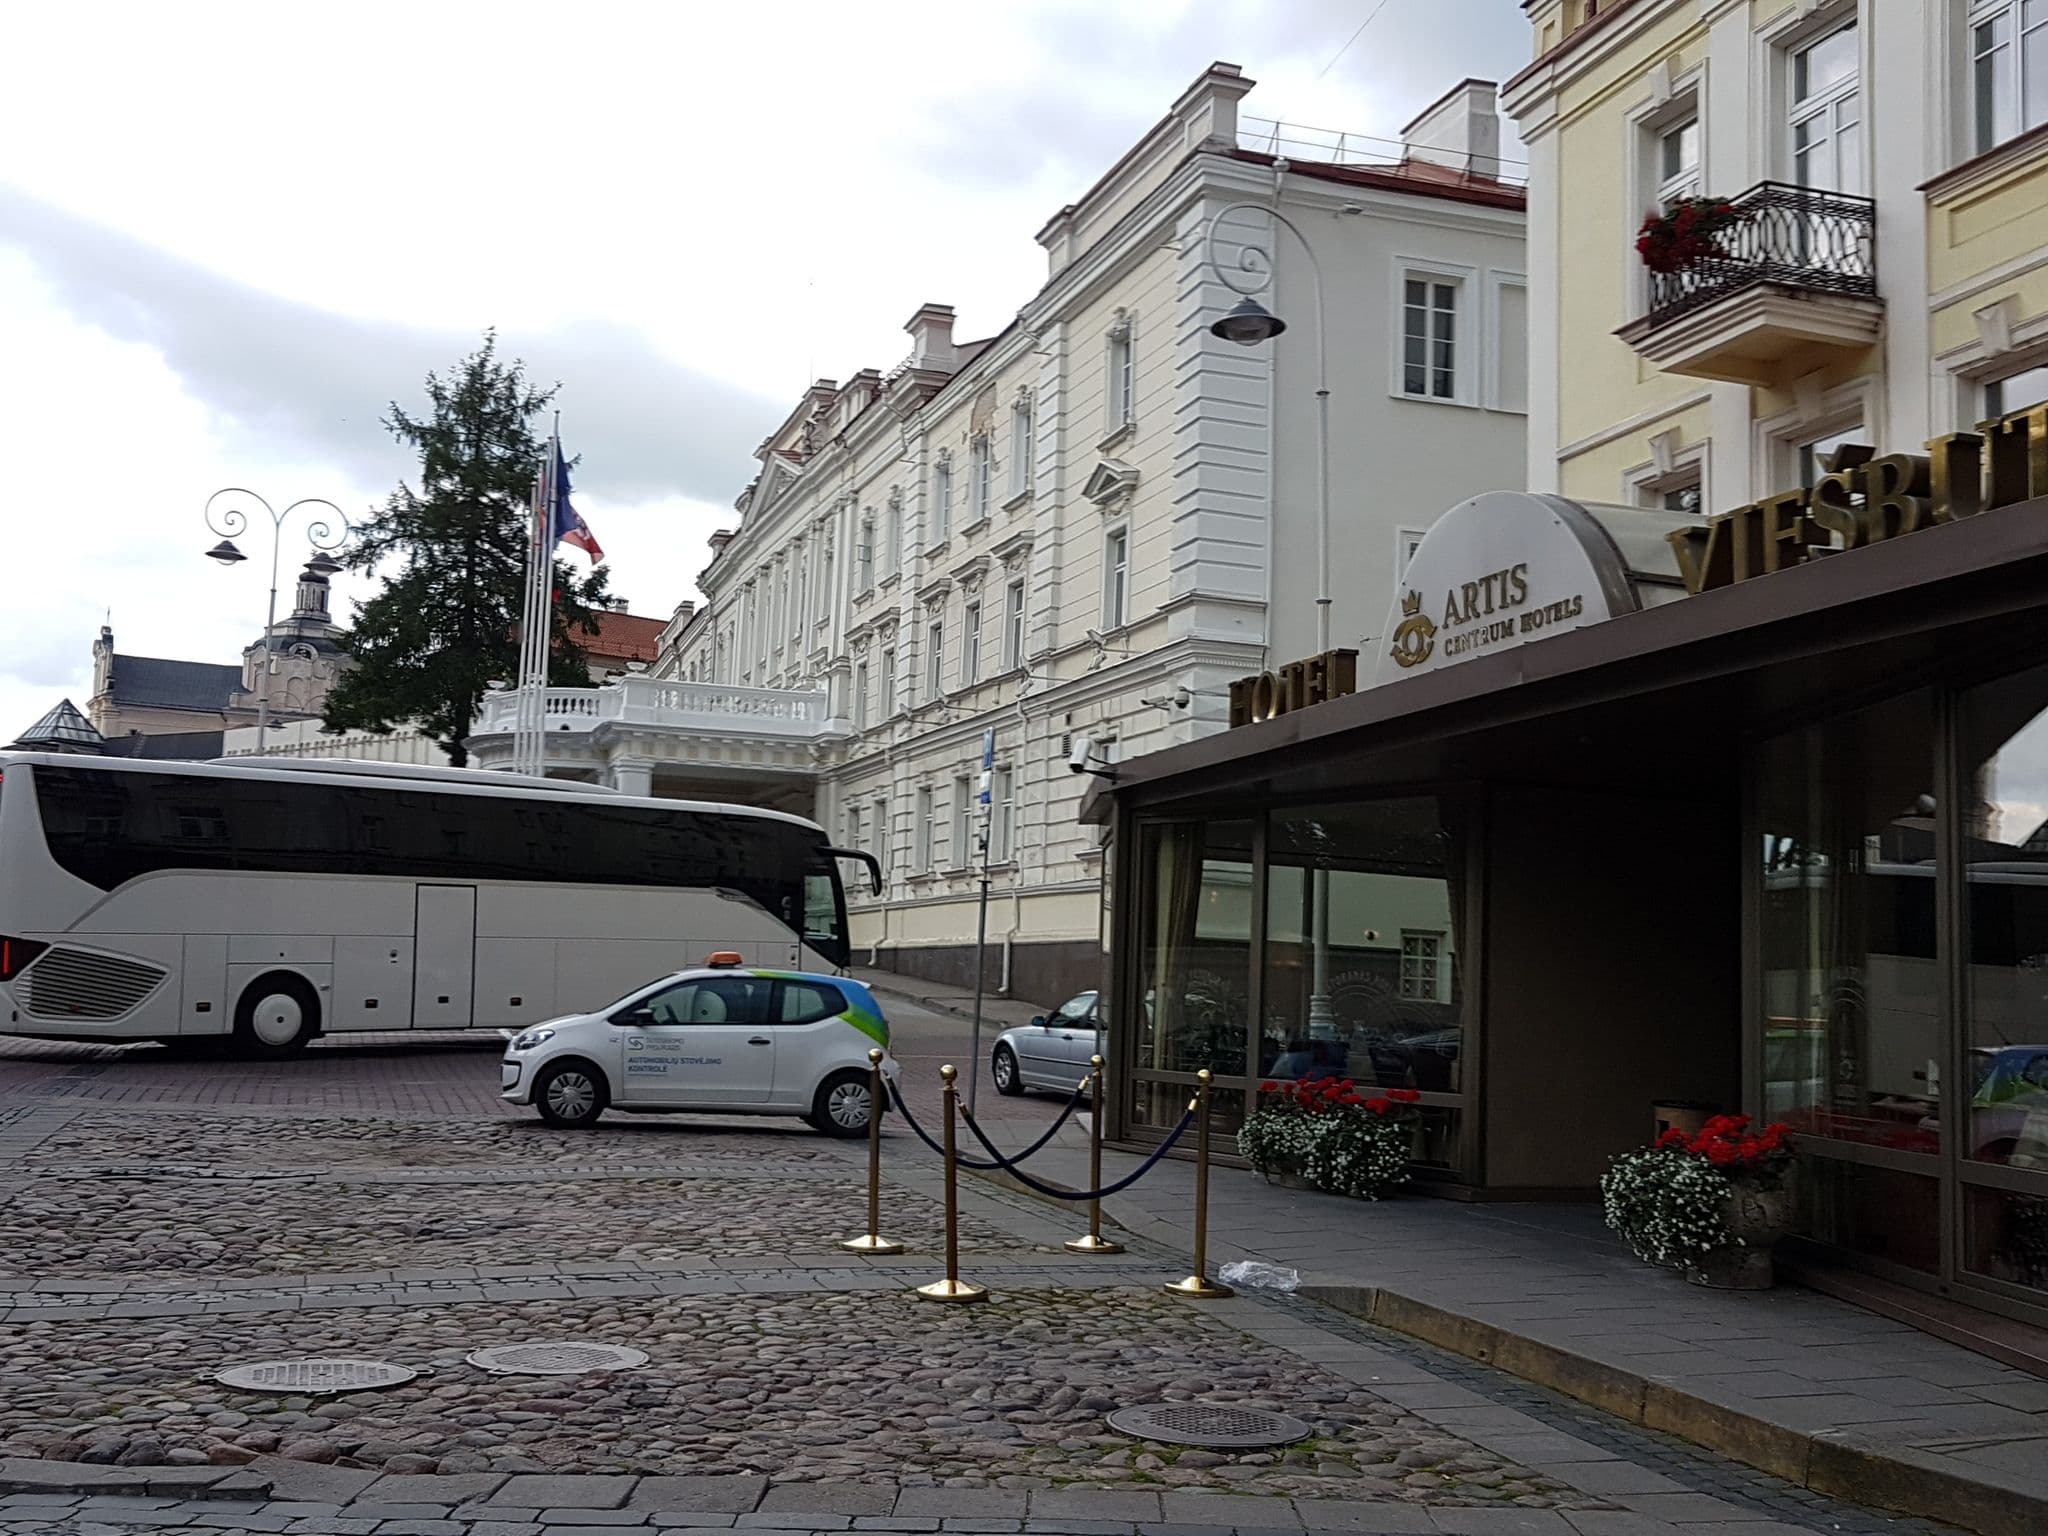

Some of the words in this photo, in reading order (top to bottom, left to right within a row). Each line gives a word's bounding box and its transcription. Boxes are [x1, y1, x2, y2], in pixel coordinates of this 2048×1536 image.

[1442, 563, 1527, 629] ARTIS
[1445, 618, 1514, 656] CENTRUM
[1520, 594, 1583, 633] HOTELS
[1229, 648, 1359, 728] HOTEL
